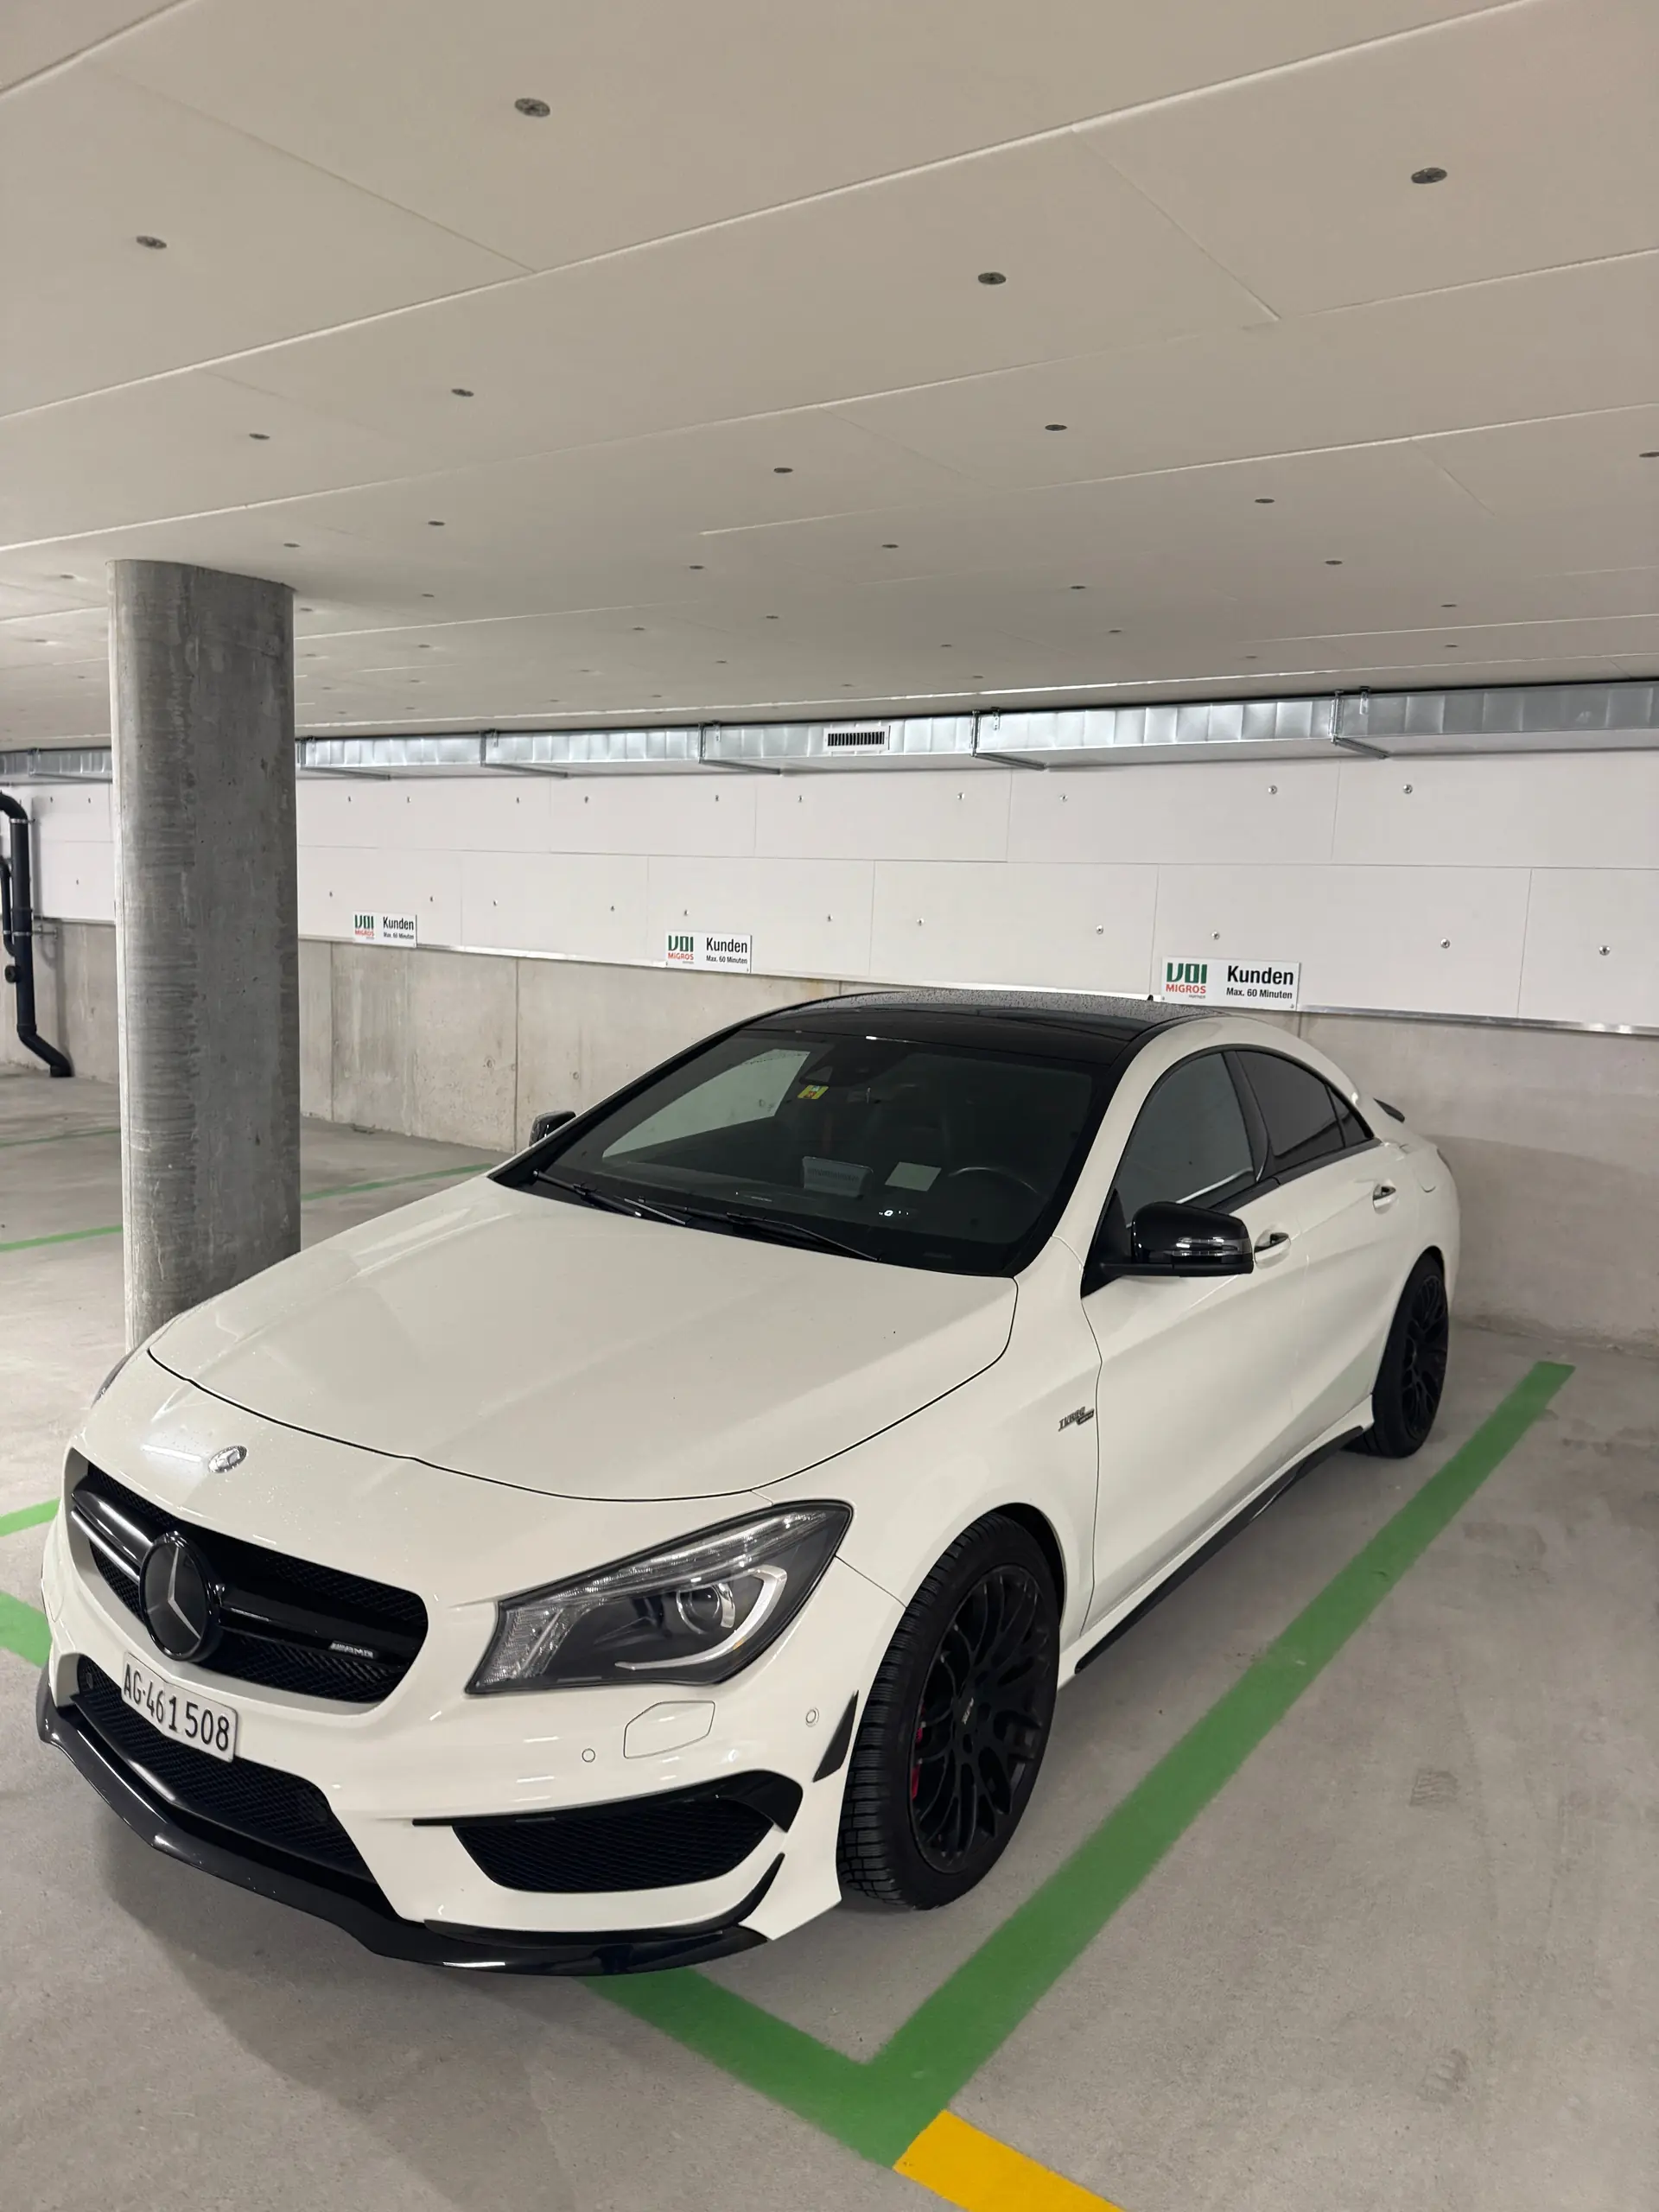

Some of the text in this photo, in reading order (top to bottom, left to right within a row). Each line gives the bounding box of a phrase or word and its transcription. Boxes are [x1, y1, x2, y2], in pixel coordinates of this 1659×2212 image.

[383, 916, 414, 931] Kunden
[668, 935, 694, 952] VOI
[706, 937, 747, 953] Kunden
[727, 957, 748, 965] Minuten
[1166, 962, 1208, 984] VOI
[1227, 965, 1294, 986] Kunden
[1166, 983, 1206, 995] MIGROS
[1226, 987, 1293, 1000] Max. 60 Minuten
